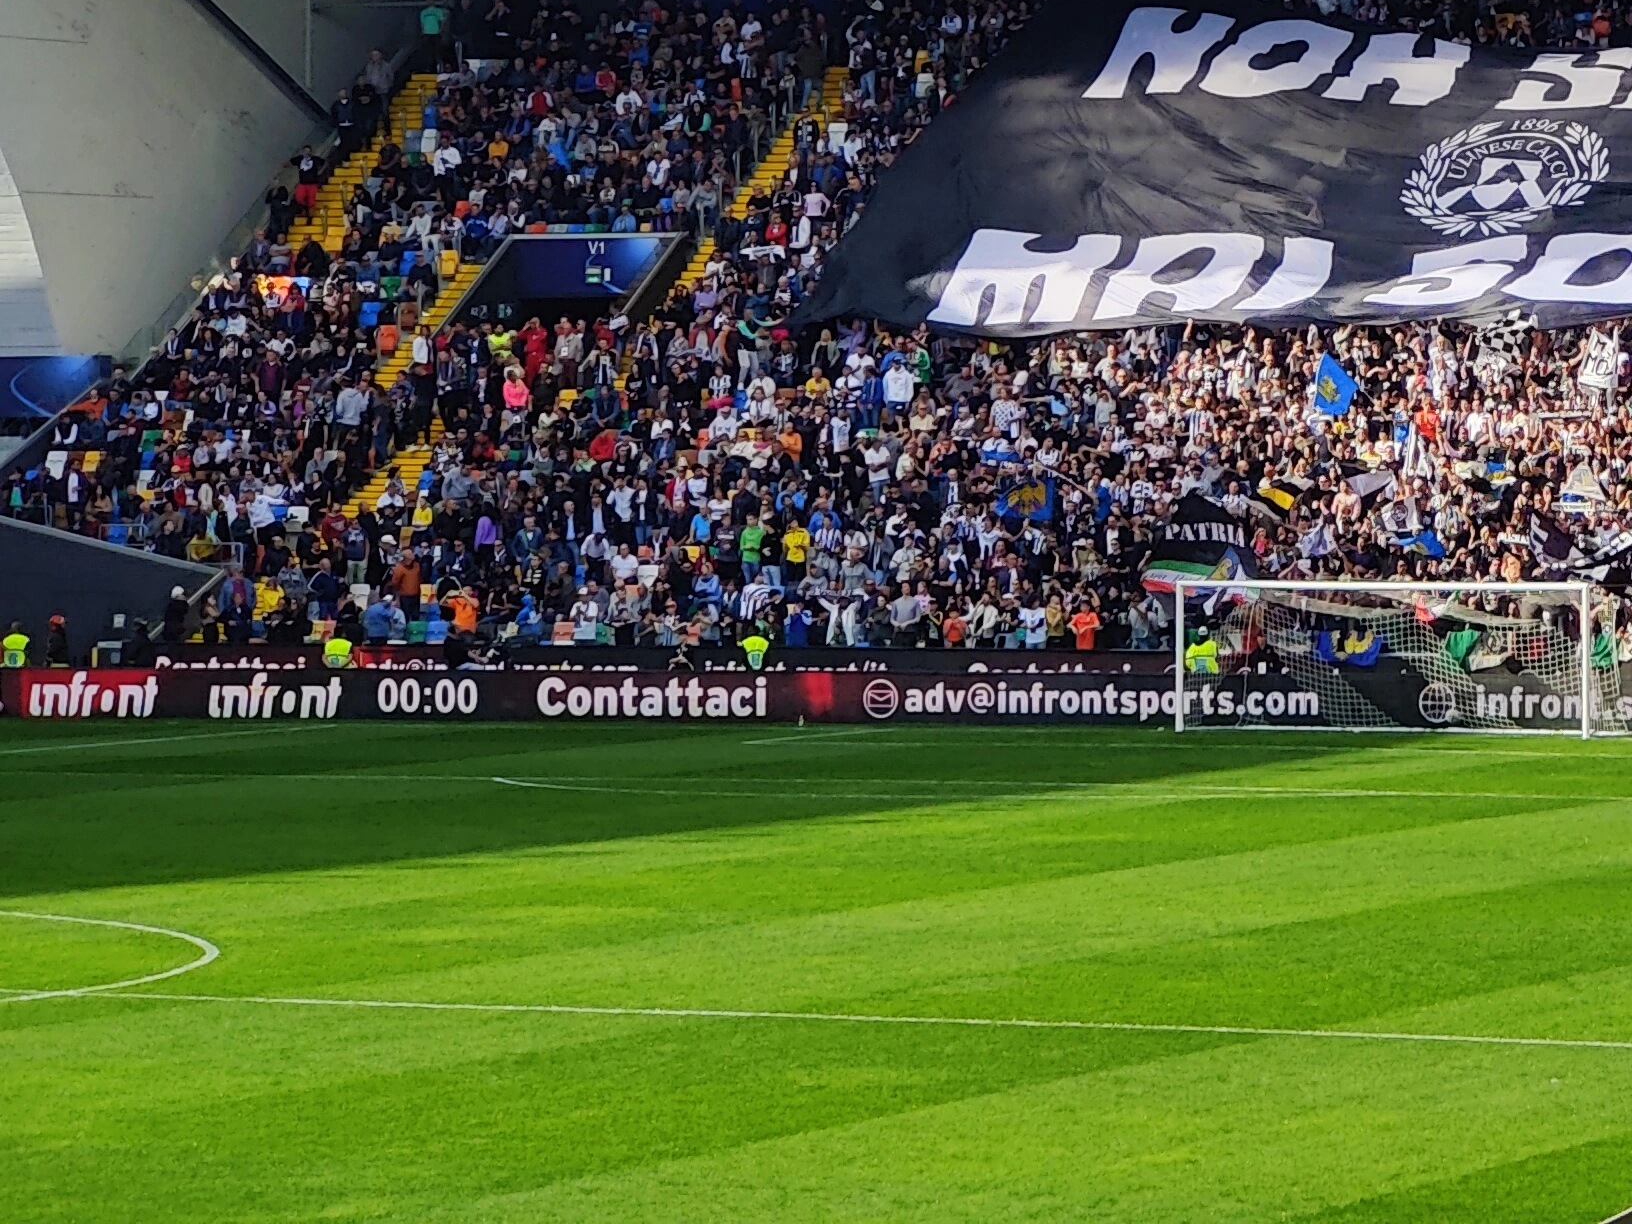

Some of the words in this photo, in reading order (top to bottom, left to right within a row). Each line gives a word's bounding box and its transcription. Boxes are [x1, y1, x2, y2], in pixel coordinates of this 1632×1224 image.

[1081, 6, 1471, 107] NON
[1509, 117, 1562, 133] 1896
[587, 240, 605, 255] V1
[926, 228, 1334, 326] MAI
[1165, 522, 1246, 548] PATRIA
[28, 670, 159, 718] infront
[208, 672, 342, 720] infront
[377, 677, 478, 714] 00:00
[536, 676, 767, 717] Contattaci
[904, 680, 1319, 721] adv@infrontsports.com
